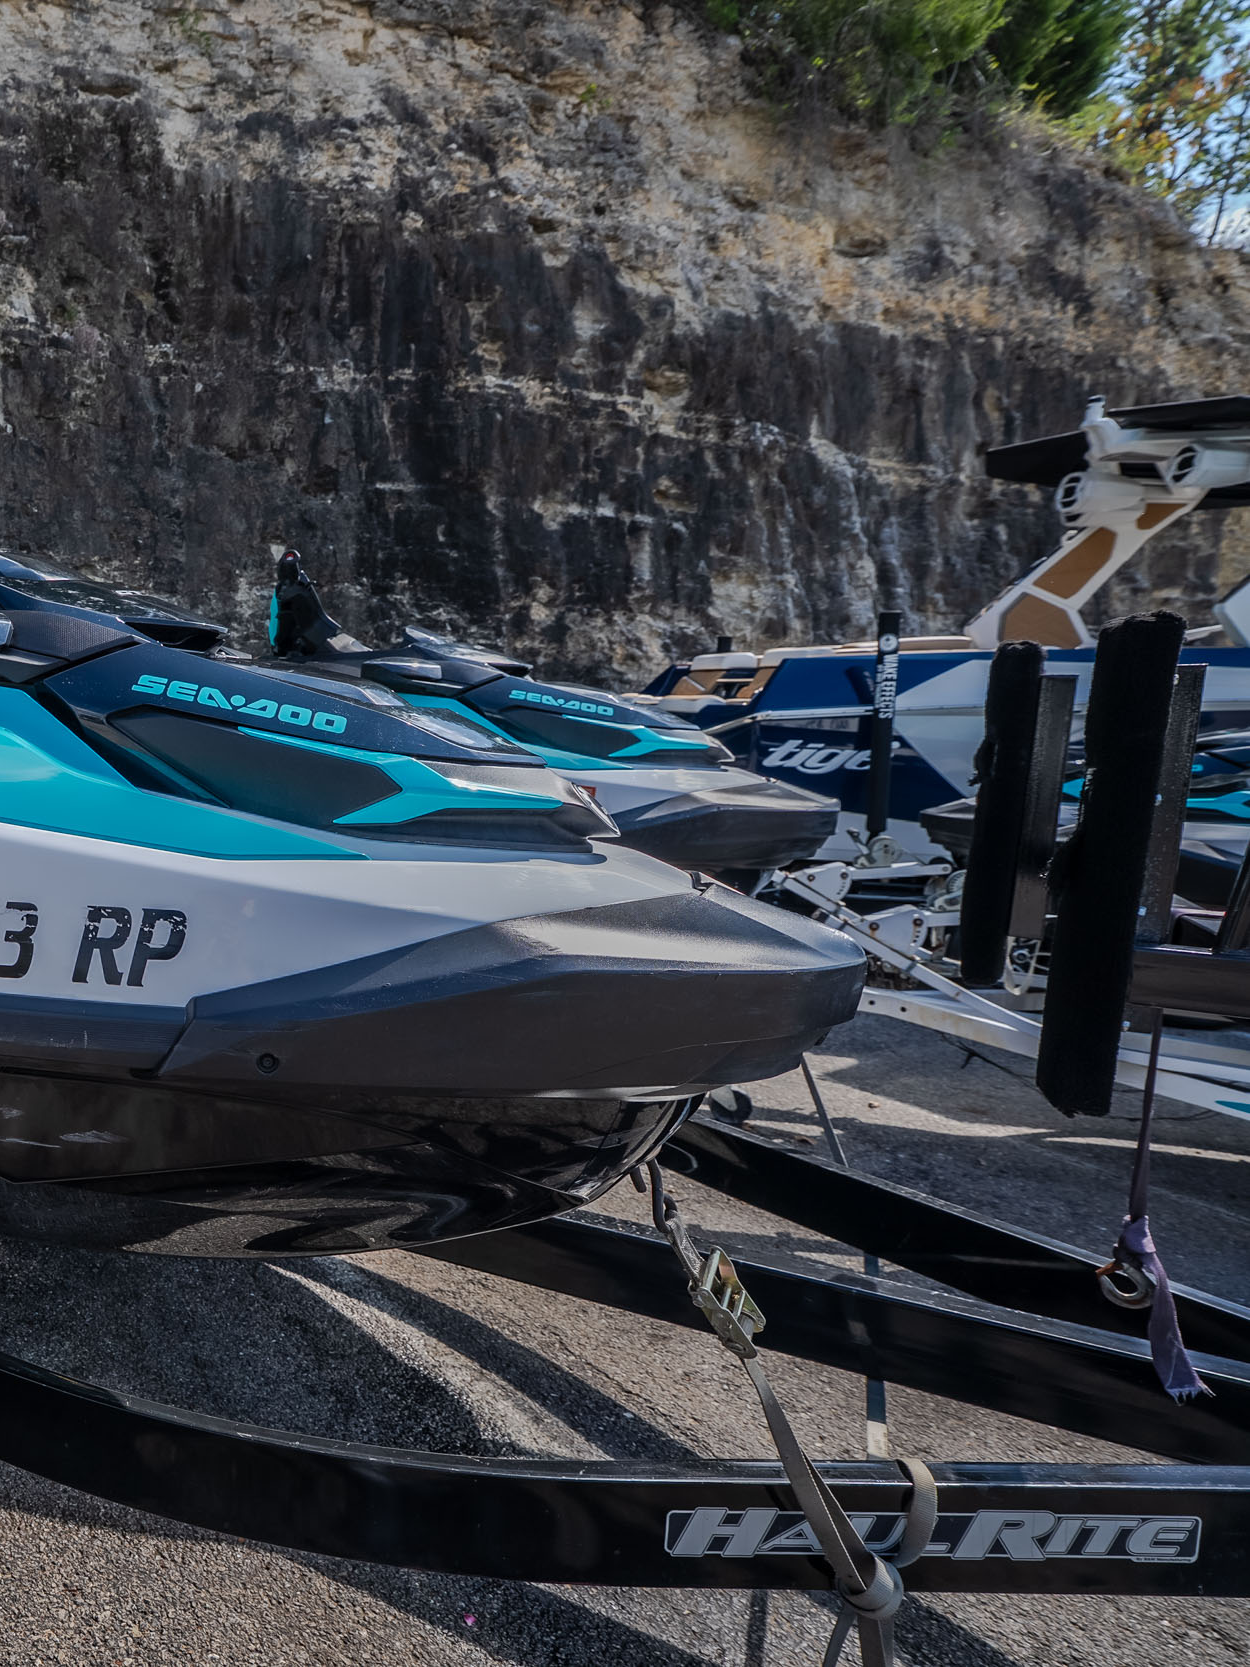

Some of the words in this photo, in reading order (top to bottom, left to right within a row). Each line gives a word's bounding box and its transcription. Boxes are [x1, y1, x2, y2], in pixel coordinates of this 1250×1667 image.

[883, 654, 899, 680] WAKE
[878, 681, 897, 719] EFFECTS
[71, 904, 188, 988] RP
